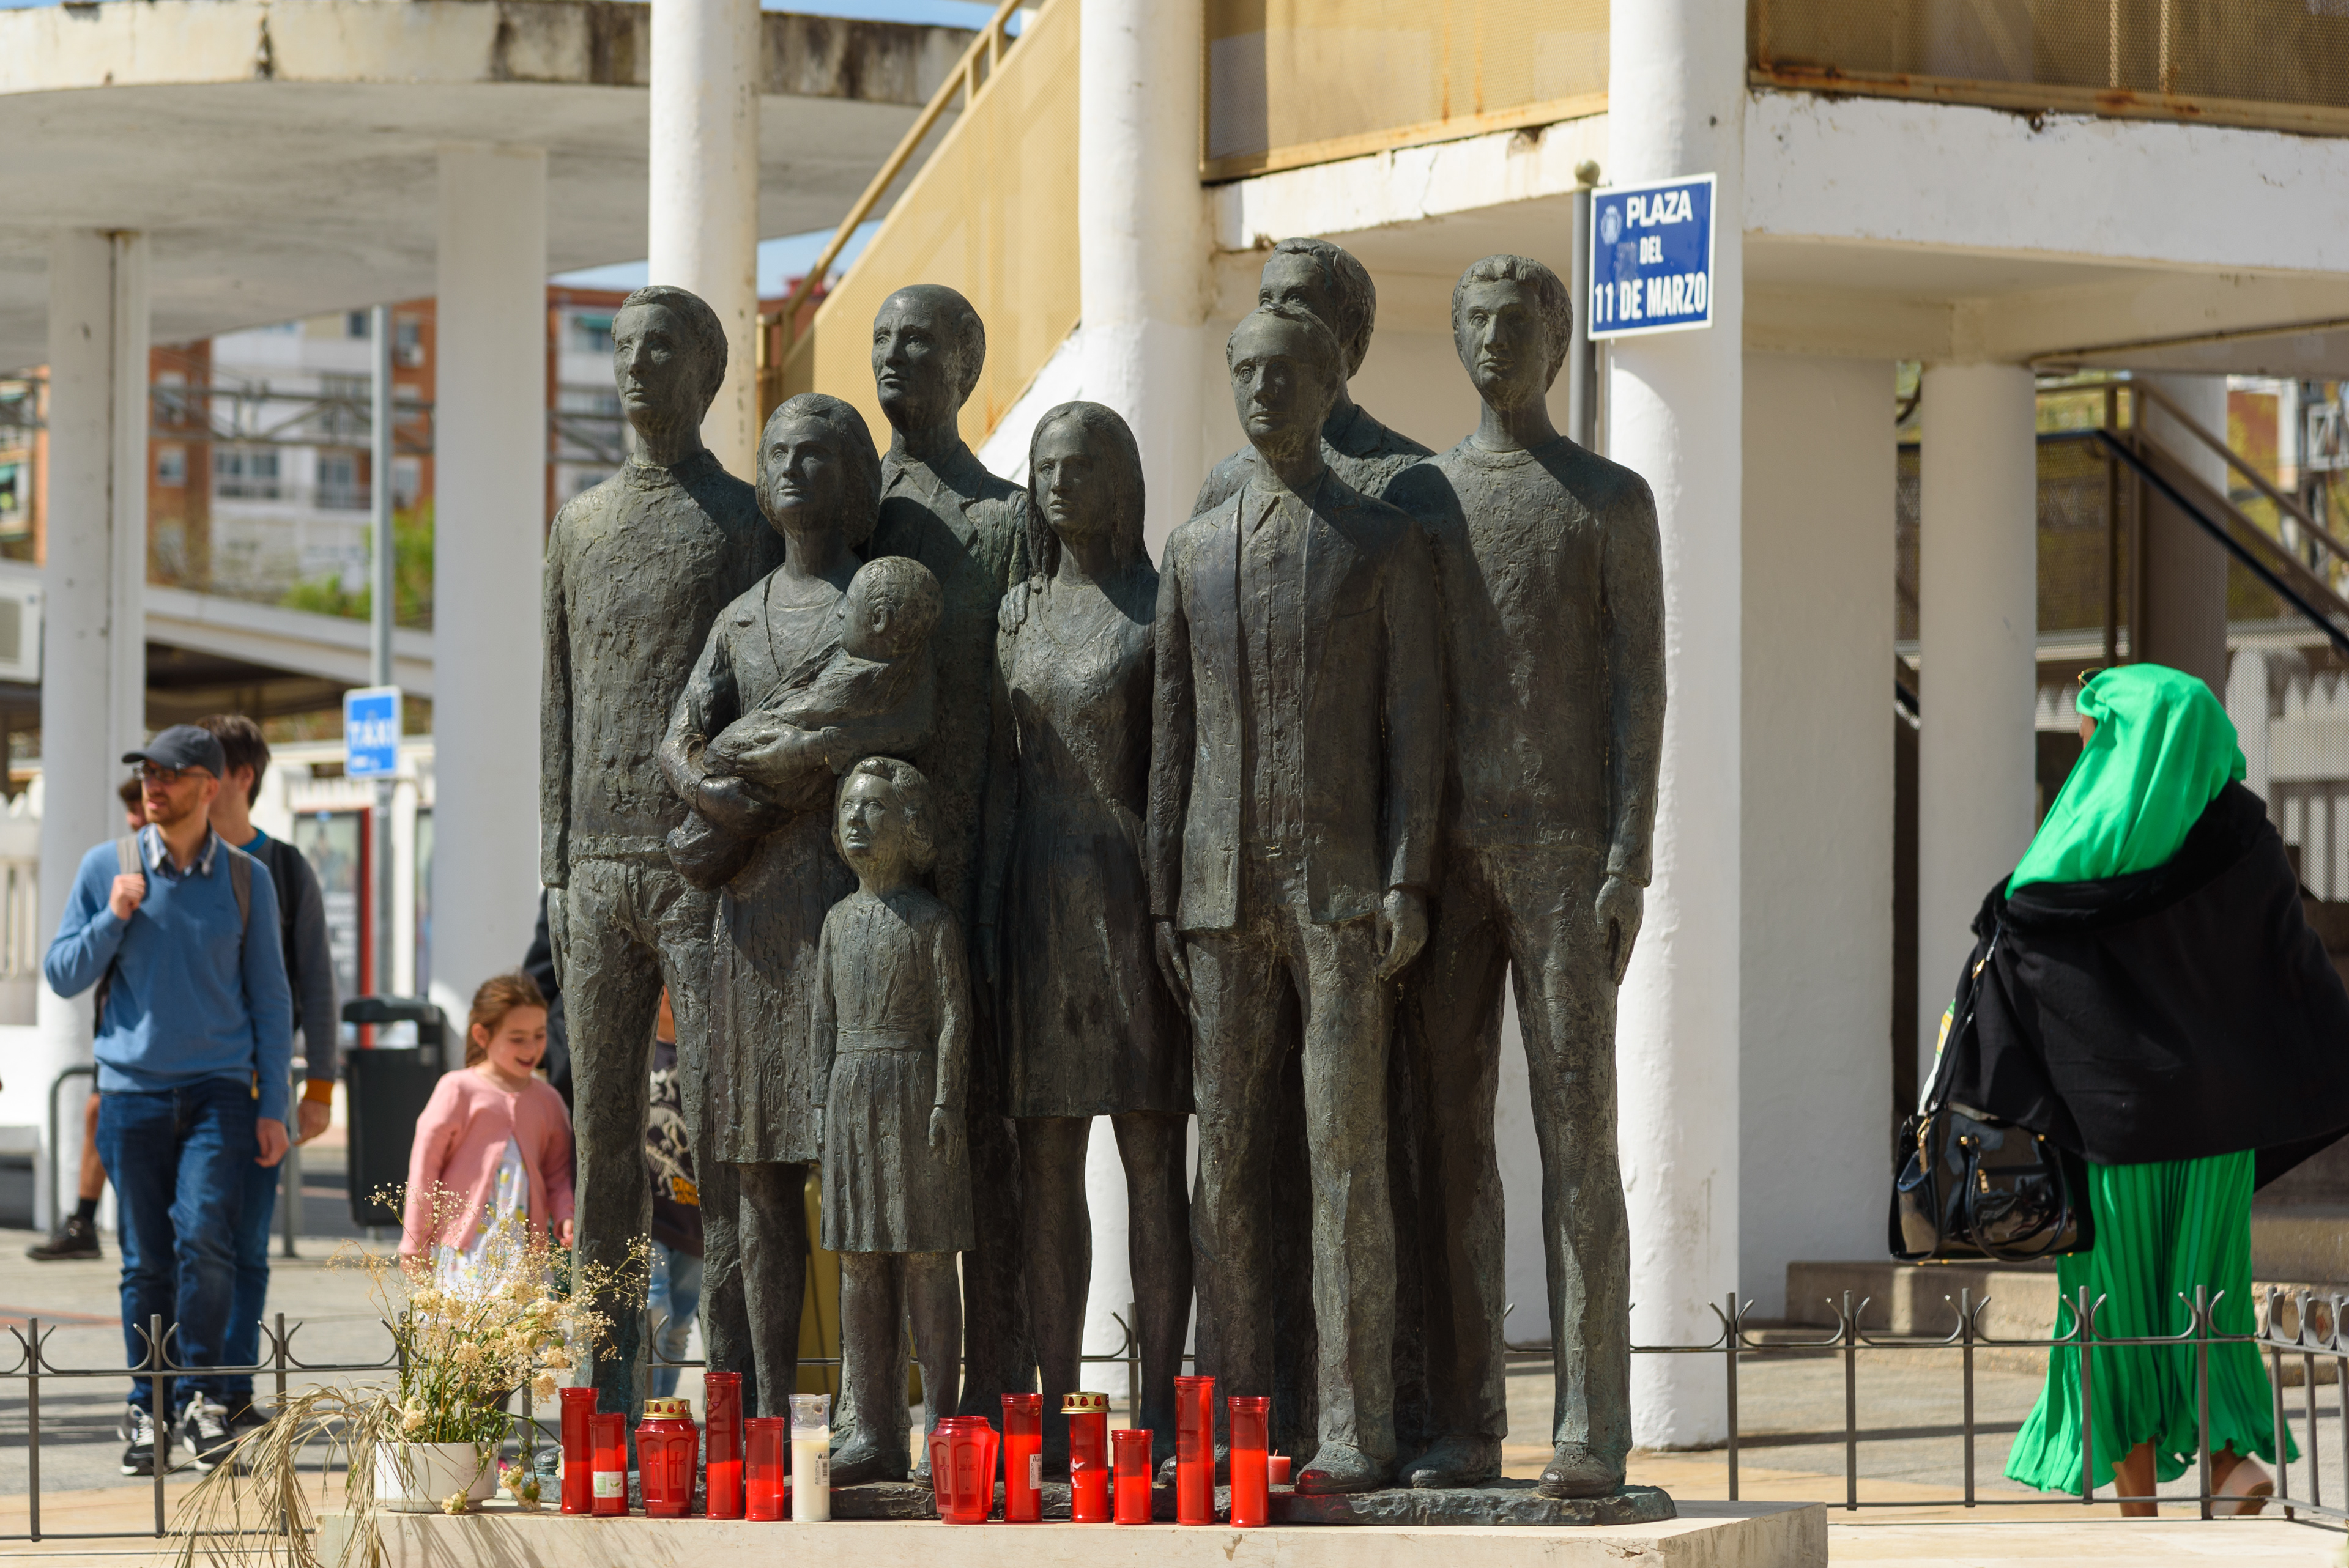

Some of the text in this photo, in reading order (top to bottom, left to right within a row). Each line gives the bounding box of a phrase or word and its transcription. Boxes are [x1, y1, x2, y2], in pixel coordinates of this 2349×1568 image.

[1627, 190, 1693, 229] PLAZA
[1639, 235, 1663, 264] DEL
[1595, 272, 1707, 324] 11 DE MARZO
